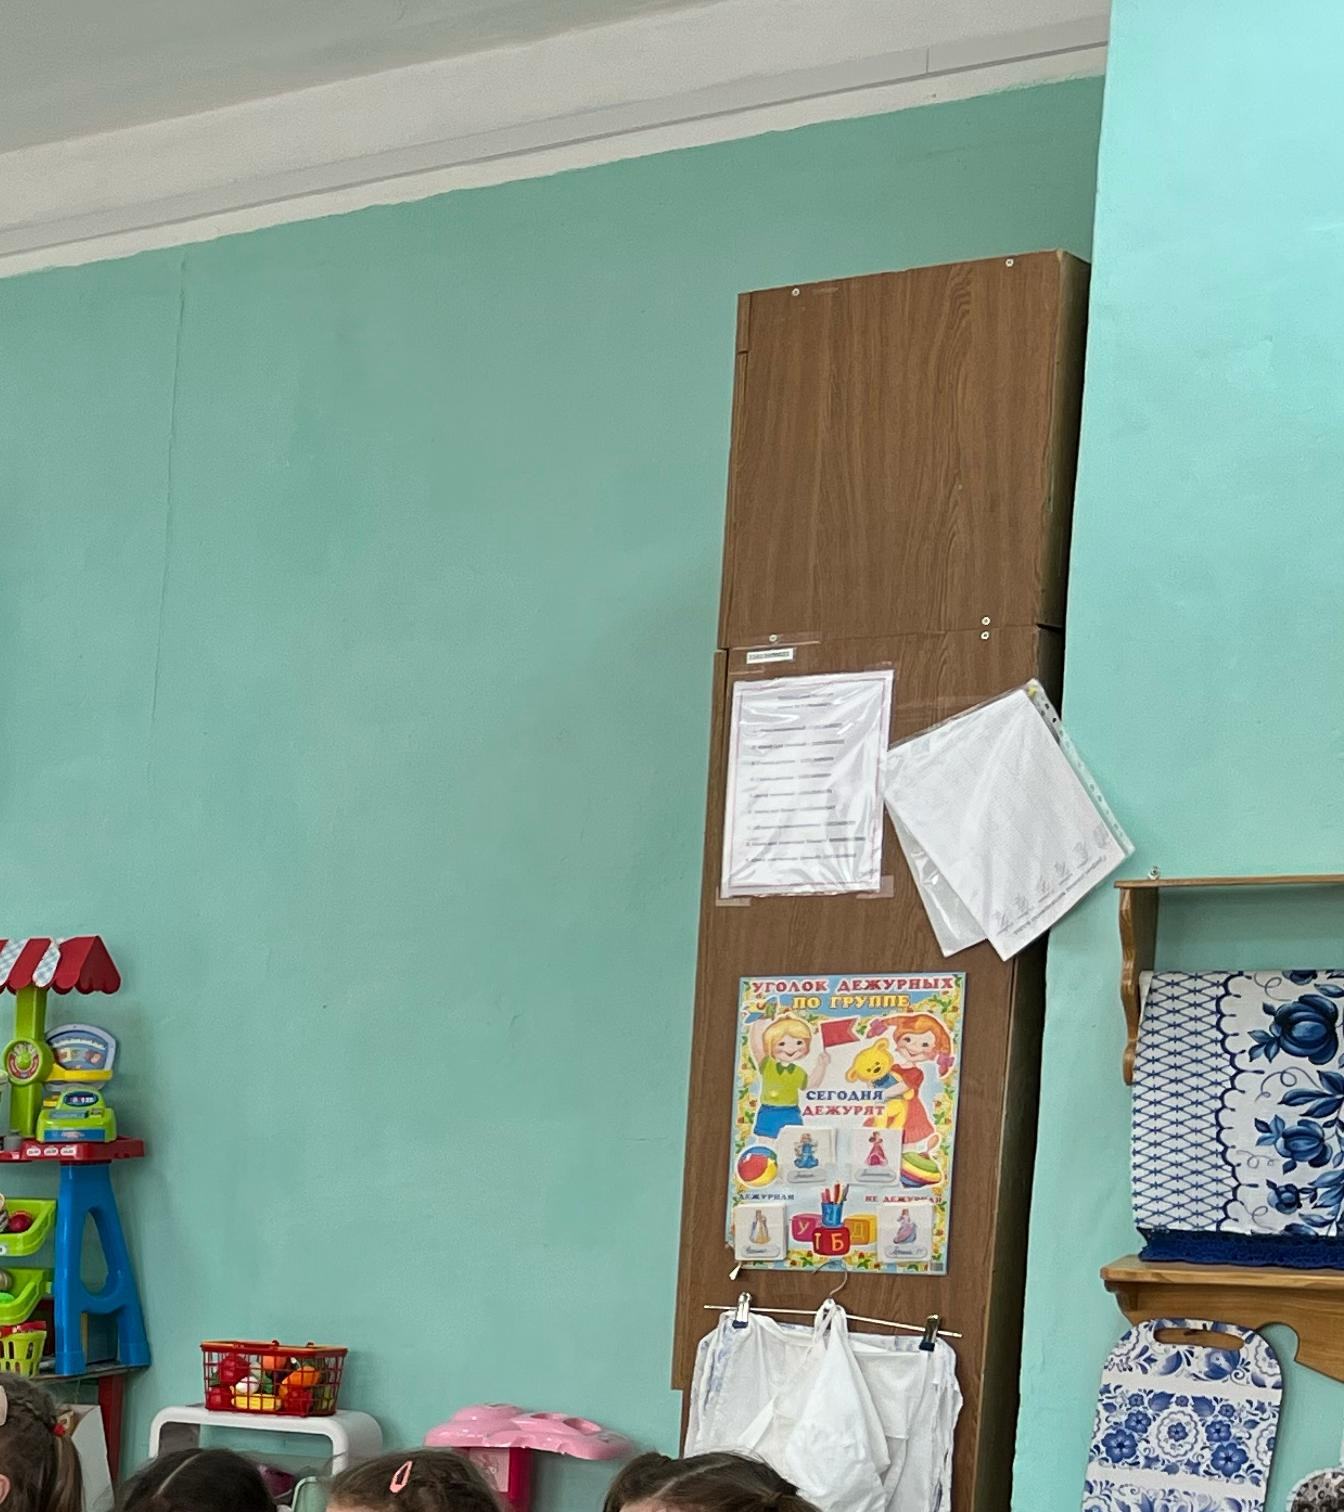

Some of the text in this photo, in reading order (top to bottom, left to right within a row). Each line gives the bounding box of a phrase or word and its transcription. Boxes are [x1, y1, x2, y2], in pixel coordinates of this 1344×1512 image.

[752, 976, 954, 994] УГОЛОК ДЕЖУРНЫХ
[792, 994, 910, 1010] ПО ГРУППЕ
[806, 1089, 883, 1102] СЕГОДНЯ
[802, 1104, 885, 1118] ДЕЖУРЯТ
